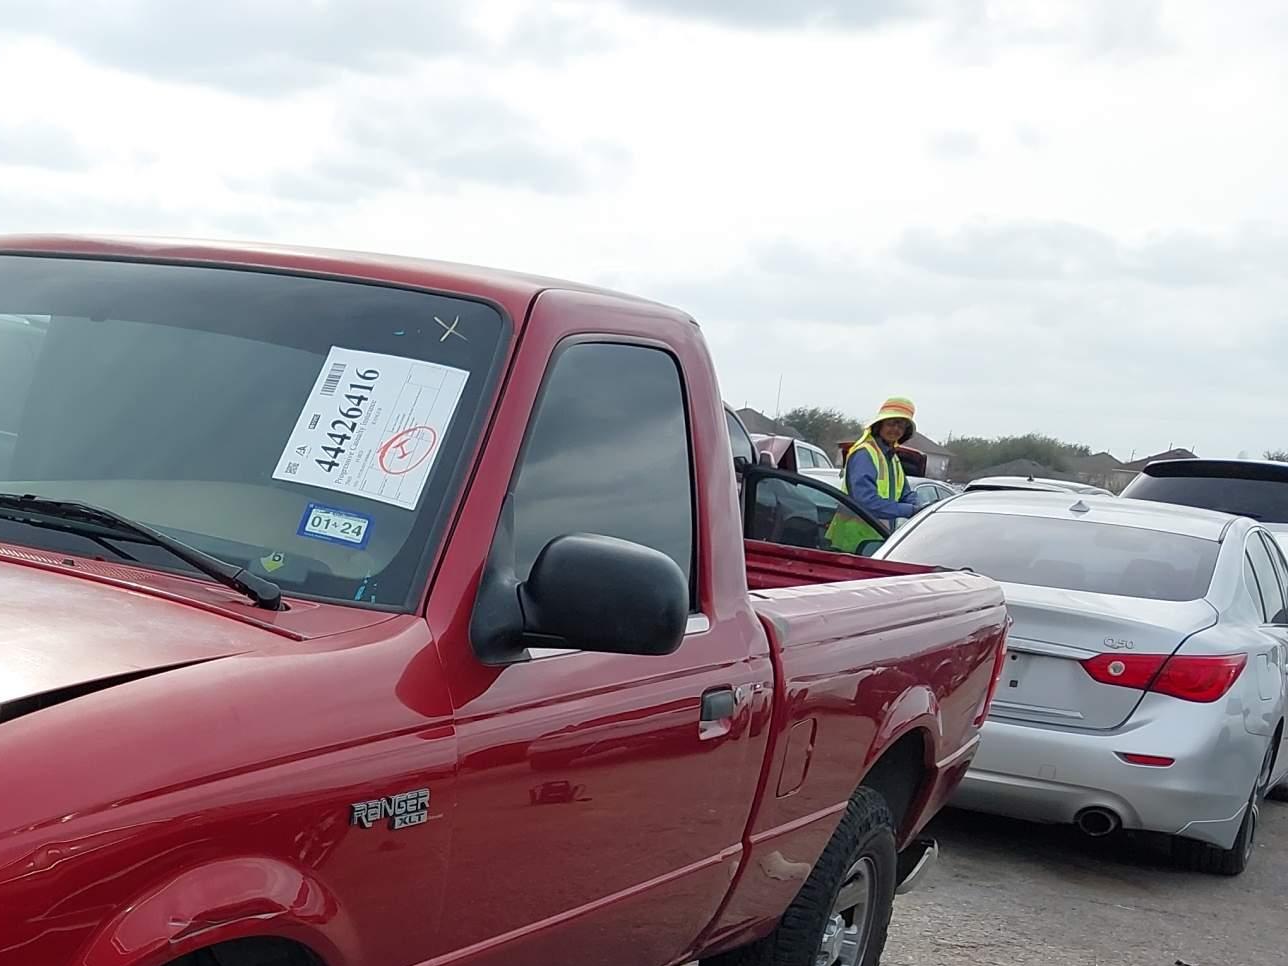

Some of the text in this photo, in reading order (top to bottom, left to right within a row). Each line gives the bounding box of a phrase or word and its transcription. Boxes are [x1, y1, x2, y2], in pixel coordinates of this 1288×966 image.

[315, 368, 379, 473] 44426416
[311, 515, 363, 537] 01 24
[350, 787, 430, 828] RANGER
[398, 812, 426, 826] XLT
